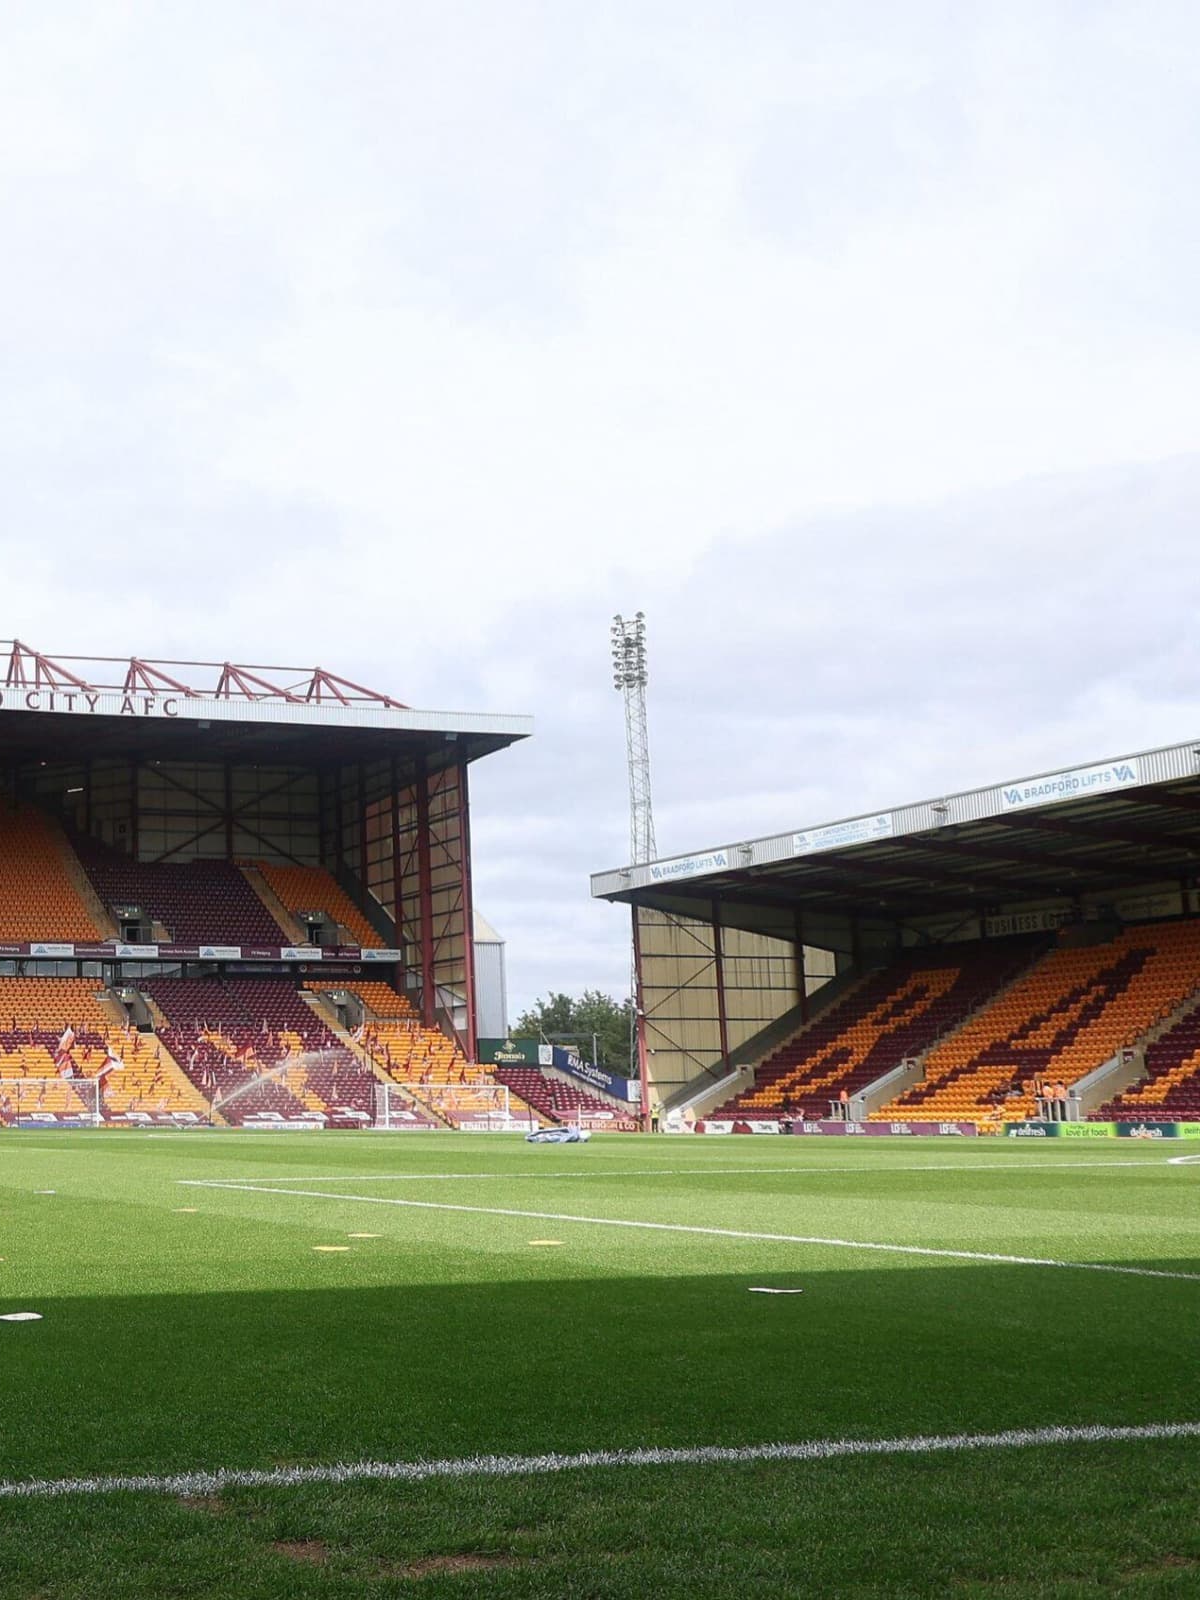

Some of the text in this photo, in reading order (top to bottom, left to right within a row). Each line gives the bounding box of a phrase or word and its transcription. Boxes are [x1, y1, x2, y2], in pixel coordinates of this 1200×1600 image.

[25, 691, 100, 712] CITY
[120, 696, 178, 717] AFC
[1023, 778, 1080, 799] BRADFORD
[1081, 771, 1112, 787] LIFTS
[662, 862, 695, 875] BRADFORD
[696, 858, 713, 869] LIFTS
[567, 1054, 584, 1072] RMA
[584, 1062, 613, 1085] Systems
[1065, 1127, 1081, 1136] love
[1091, 1127, 1108, 1136] food
